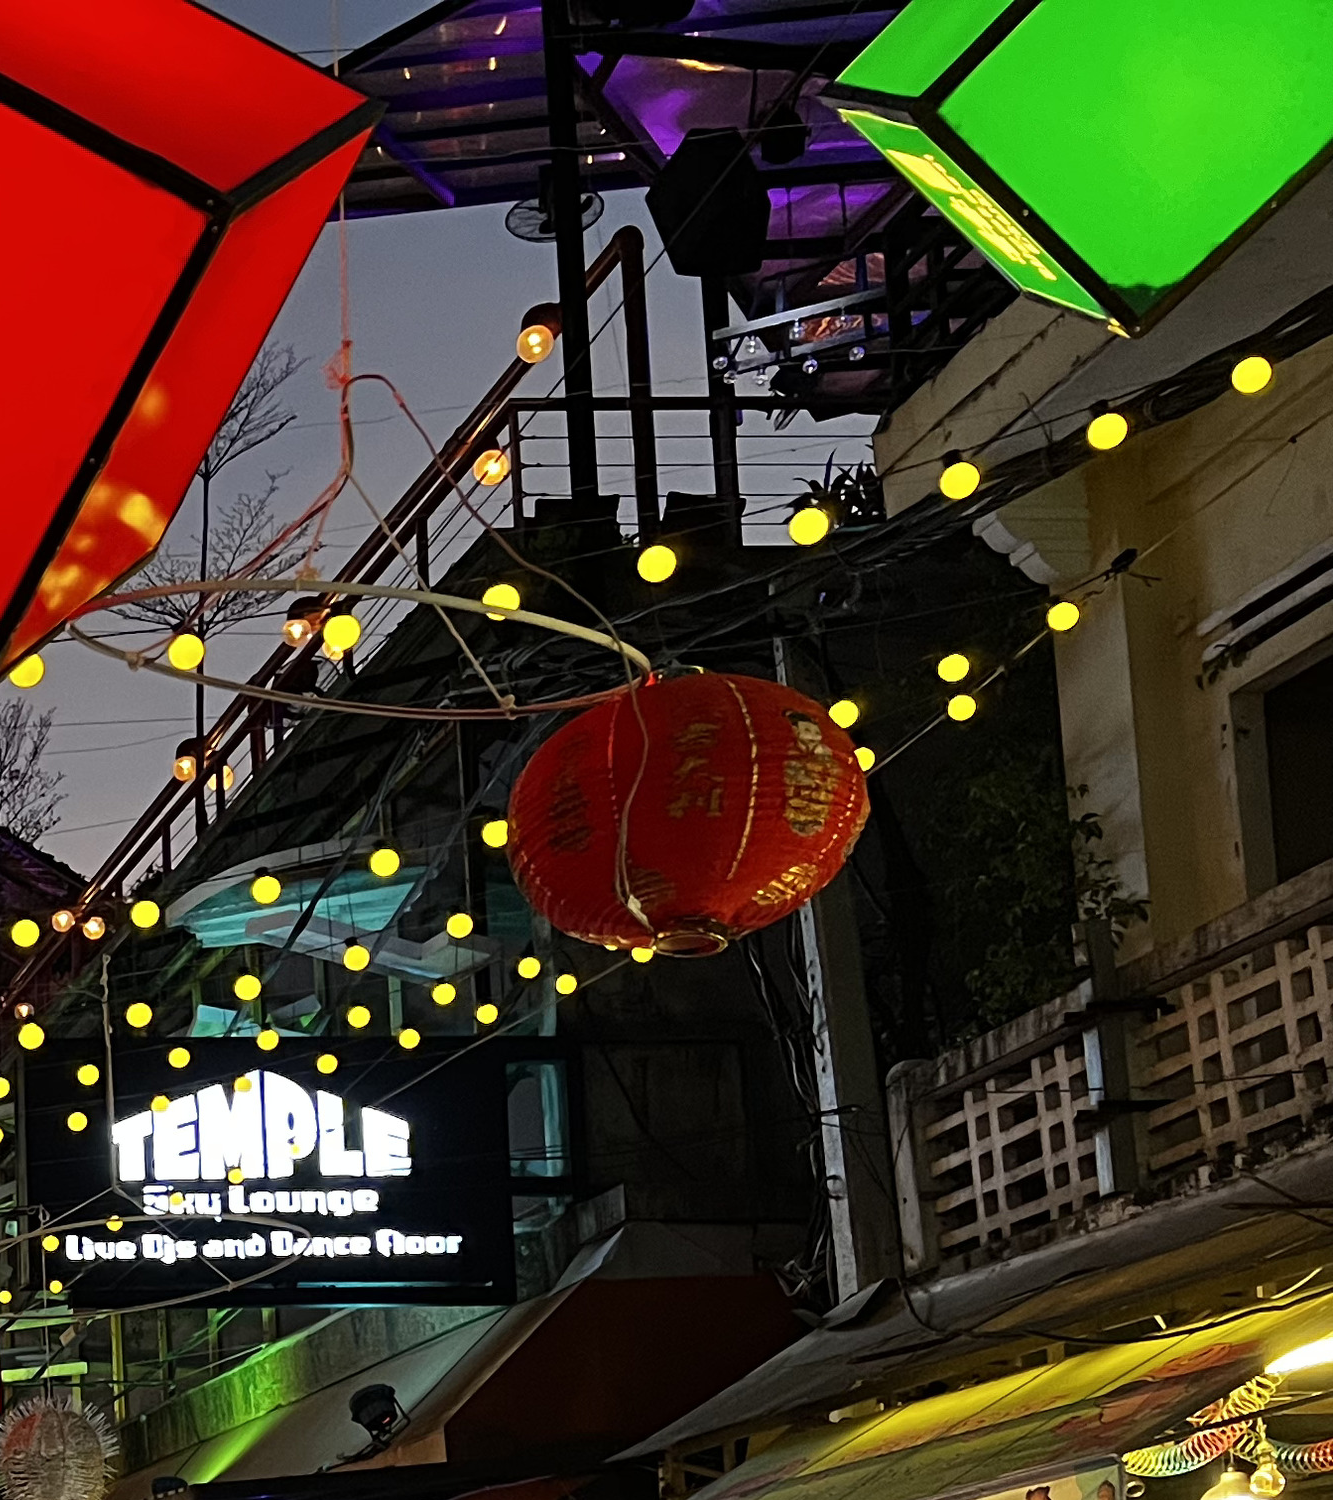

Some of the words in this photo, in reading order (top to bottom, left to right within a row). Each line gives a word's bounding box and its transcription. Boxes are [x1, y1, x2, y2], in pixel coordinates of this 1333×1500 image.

[111, 1069, 412, 1182] TEMPLE
[228, 1184, 380, 1217] Lounge
[65, 1233, 138, 1262] Live
[202, 1233, 267, 1259] and
[271, 1231, 372, 1259] Dance
